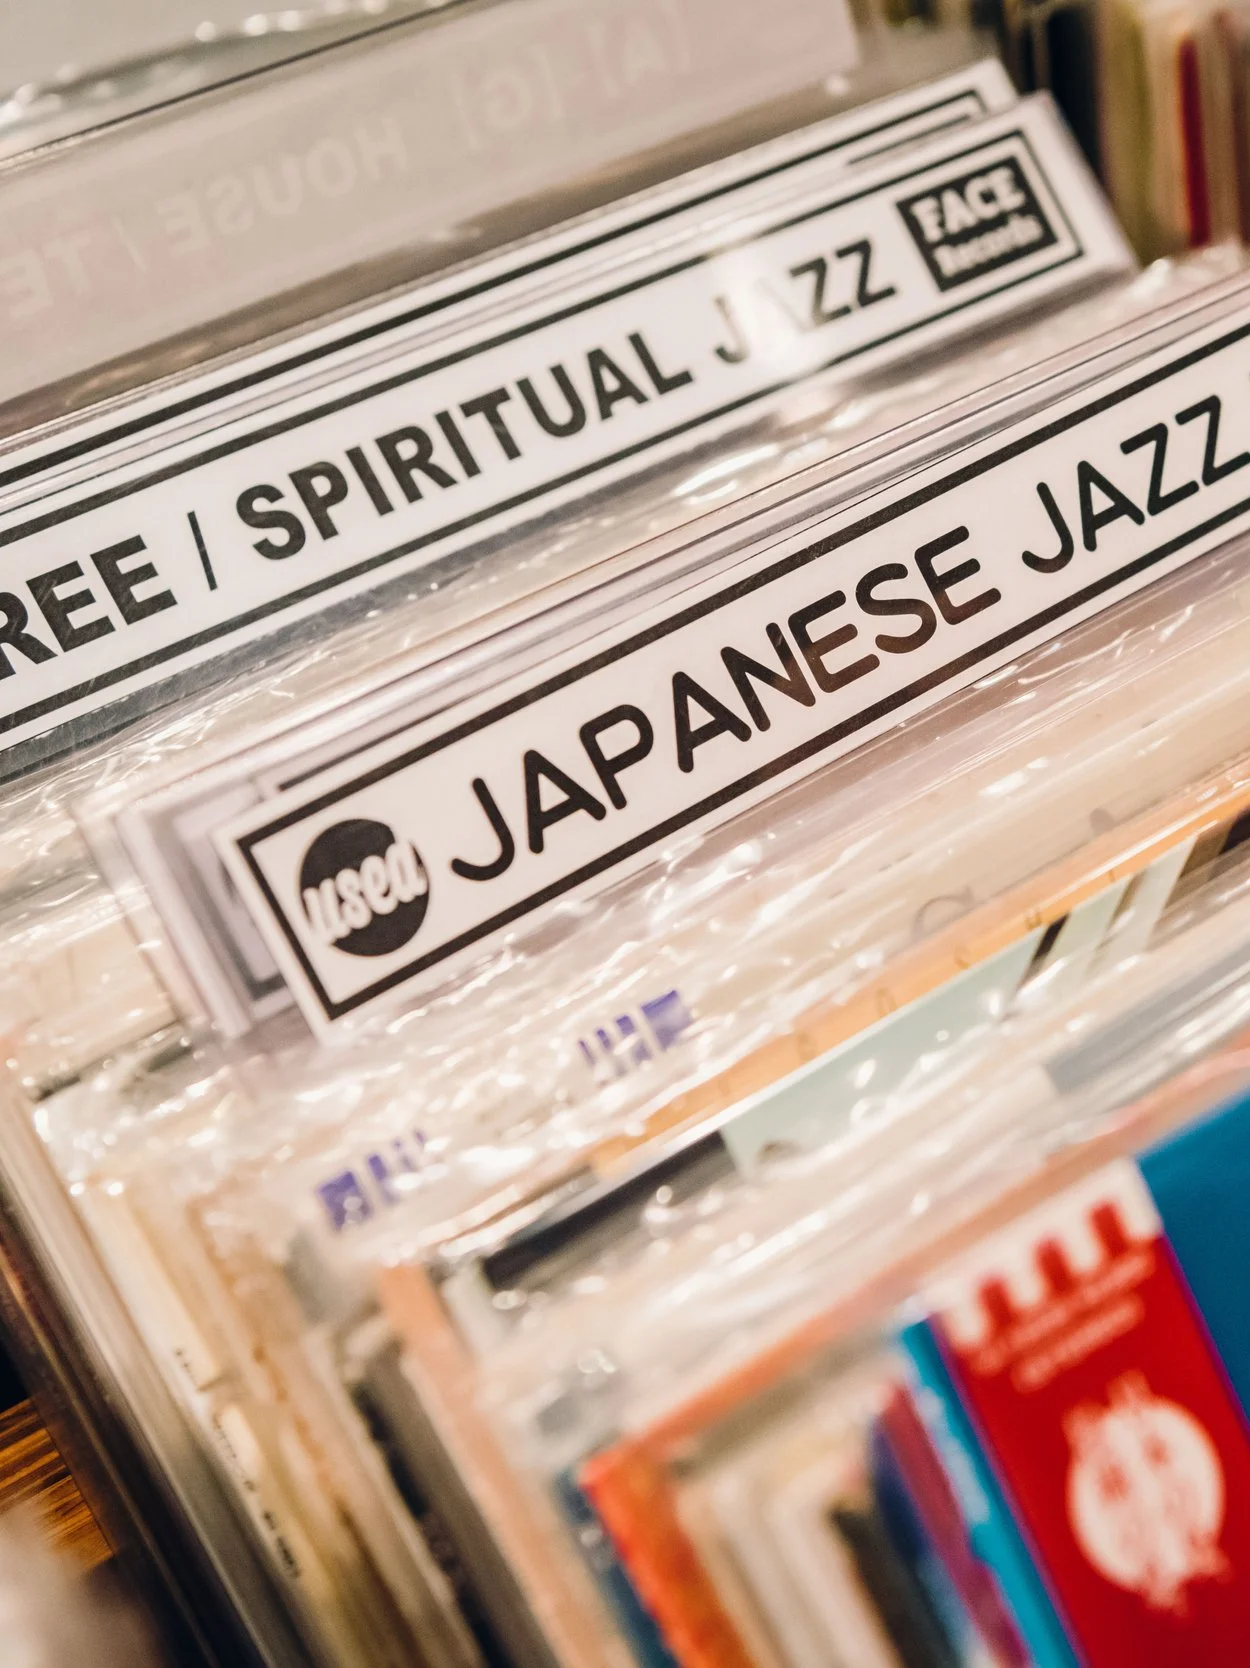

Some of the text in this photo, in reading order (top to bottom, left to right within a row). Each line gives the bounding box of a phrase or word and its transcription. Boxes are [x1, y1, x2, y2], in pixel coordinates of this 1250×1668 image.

[908, 165, 1027, 242] FACE
[931, 212, 1046, 279] Records
[187, 511, 220, 592] /
[234, 331, 694, 563] SPIRITUAL
[713, 235, 897, 364] JZZ
[451, 525, 1001, 883] JAPANESE
[302, 828, 428, 946] used
